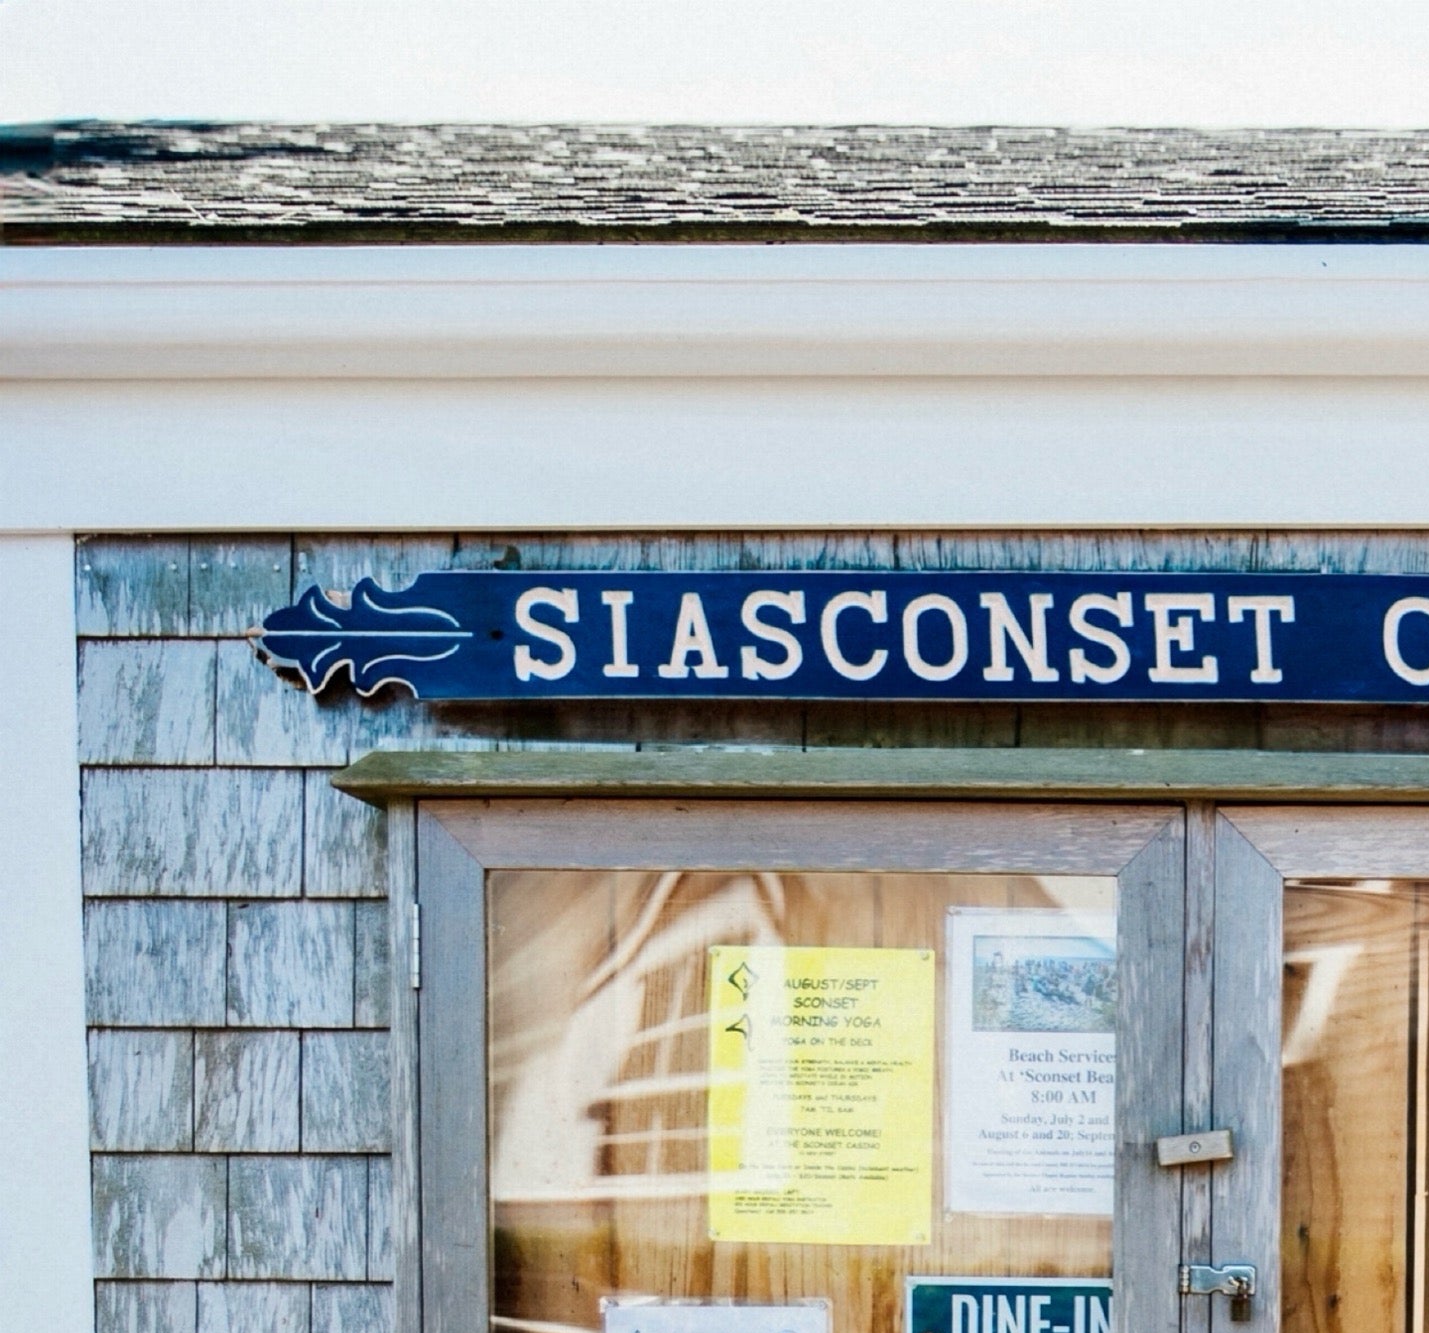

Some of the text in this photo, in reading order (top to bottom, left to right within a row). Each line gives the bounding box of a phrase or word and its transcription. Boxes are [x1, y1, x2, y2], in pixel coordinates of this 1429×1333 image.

[514, 586, 1296, 686] SIASCONSET
[784, 978, 879, 991] AUGUST/SEPT
[793, 996, 860, 1009] SCONSET
[770, 1015, 881, 1028] MORNING YOGA
[828, 1037, 846, 1047] THE
[1009, 1048, 1053, 1062] Beach
[998, 1070, 1014, 1082] At
[1031, 1090, 1097, 1104] 8:00 AM
[1001, 1113, 1109, 1126] Sunday, July 2 and
[767, 1128, 881, 1138] EVERYONE WELCOME!
[978, 1129, 1019, 1141] August
[1032, 1129, 1053, 1140] and
[847, 1141, 880, 1149] CASINO
